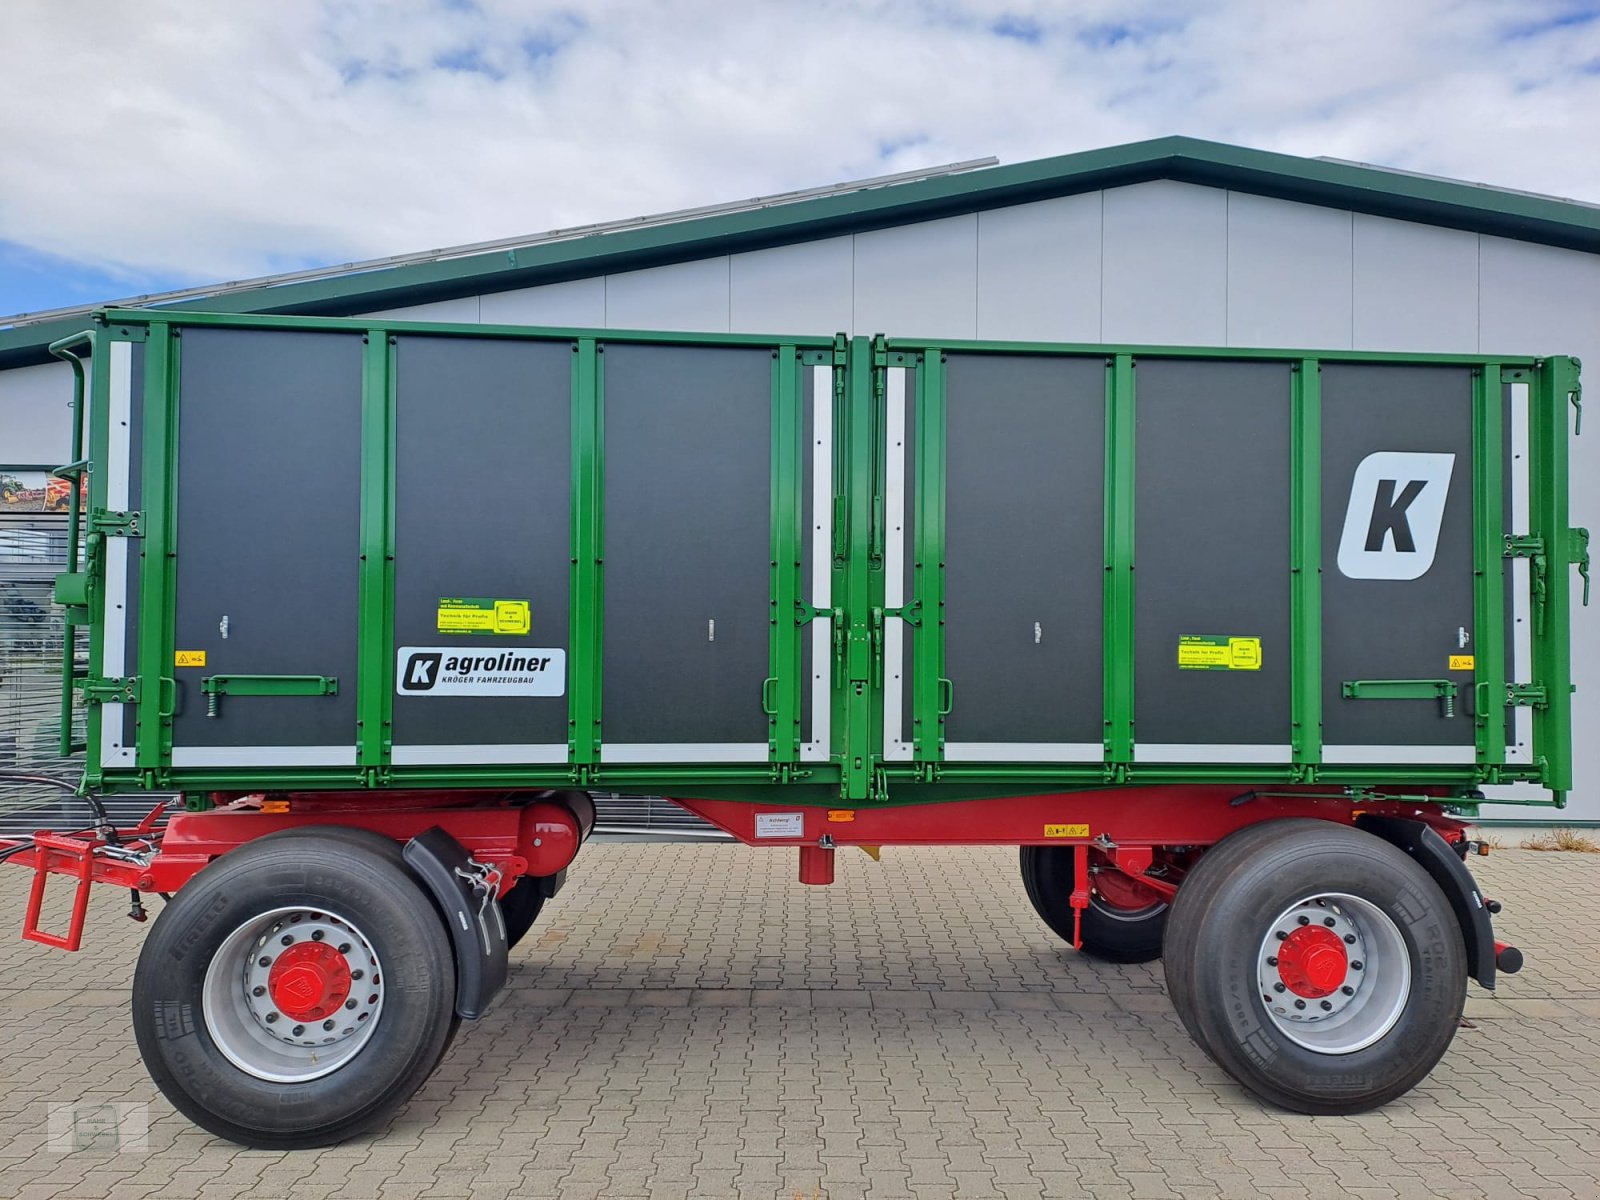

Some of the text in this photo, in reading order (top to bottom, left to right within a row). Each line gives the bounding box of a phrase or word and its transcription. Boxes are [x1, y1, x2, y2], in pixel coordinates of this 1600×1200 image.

[1364, 479, 1428, 552] K
[410, 660, 434, 684] K
[445, 652, 551, 675] agroliner
[476, 676, 534, 684] FAHRZEUGBAU
